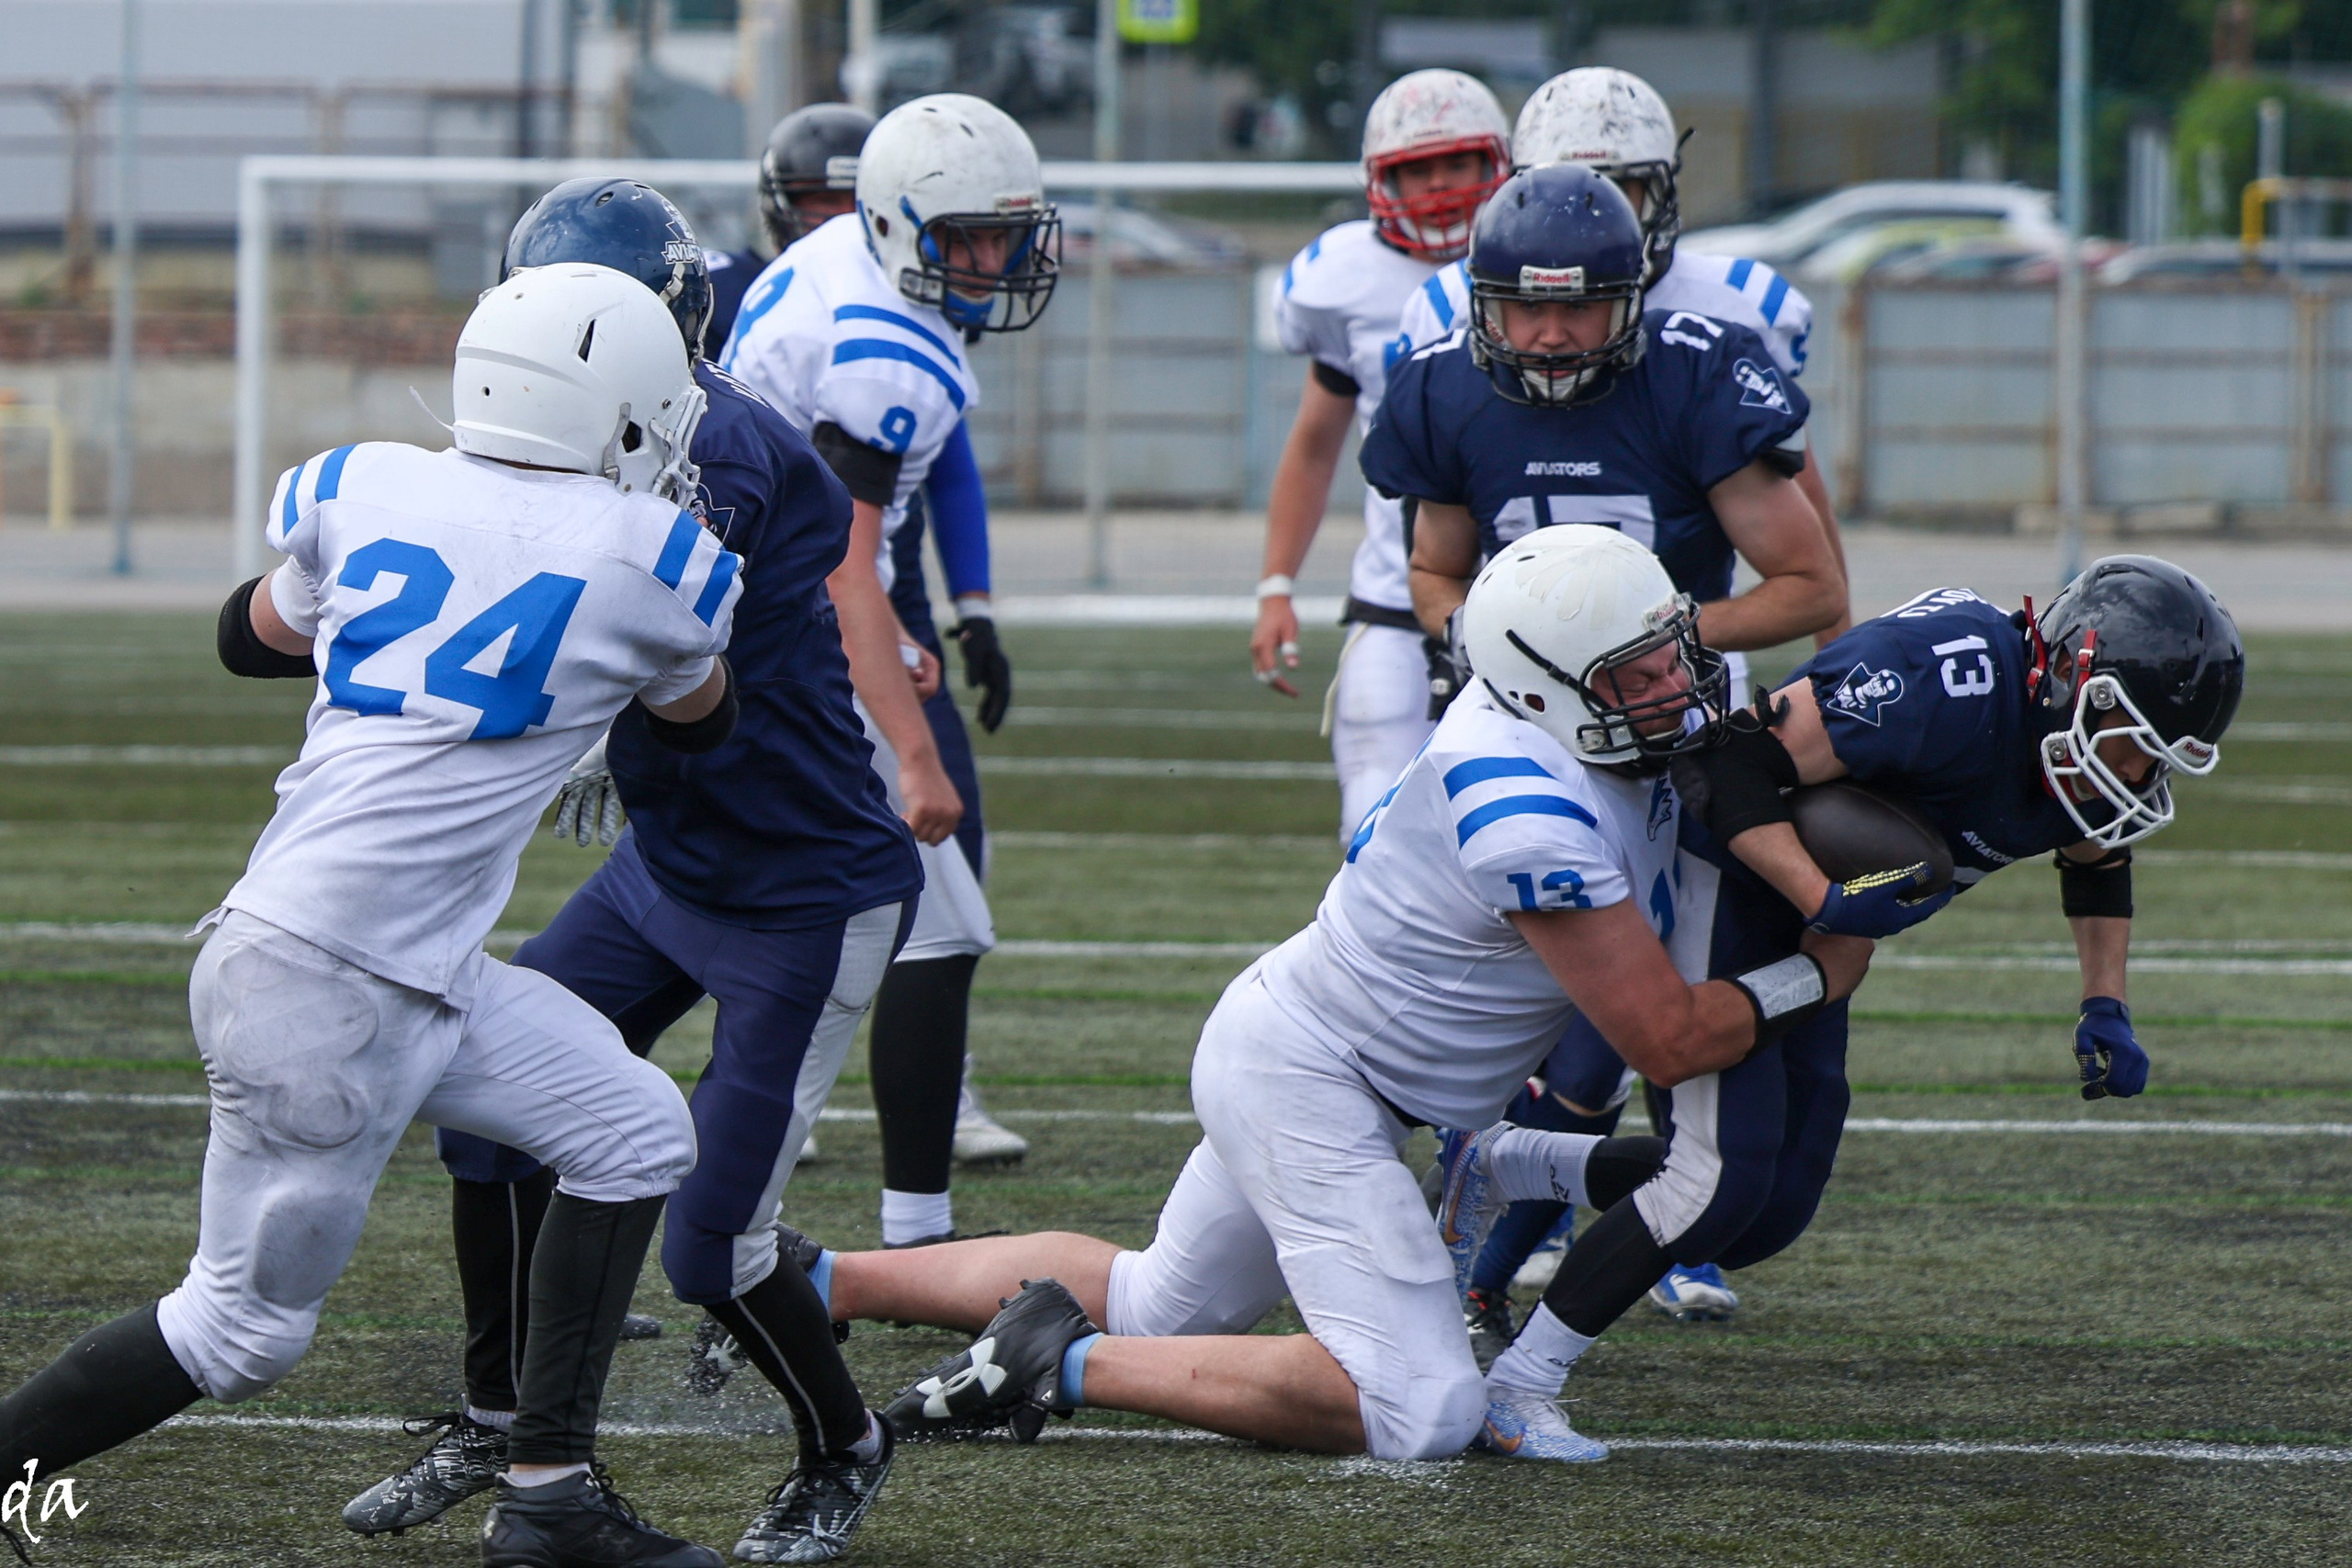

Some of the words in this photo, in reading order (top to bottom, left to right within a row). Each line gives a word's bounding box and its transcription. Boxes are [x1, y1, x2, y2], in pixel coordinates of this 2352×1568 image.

[869, 406, 917, 454] 9
[1524, 461, 1601, 477] AVIATORS
[323, 537, 588, 741] 24
[1931, 635, 1995, 698] 13
[1962, 830, 2015, 864] AVIATOR
[1507, 869, 1592, 912] 13
